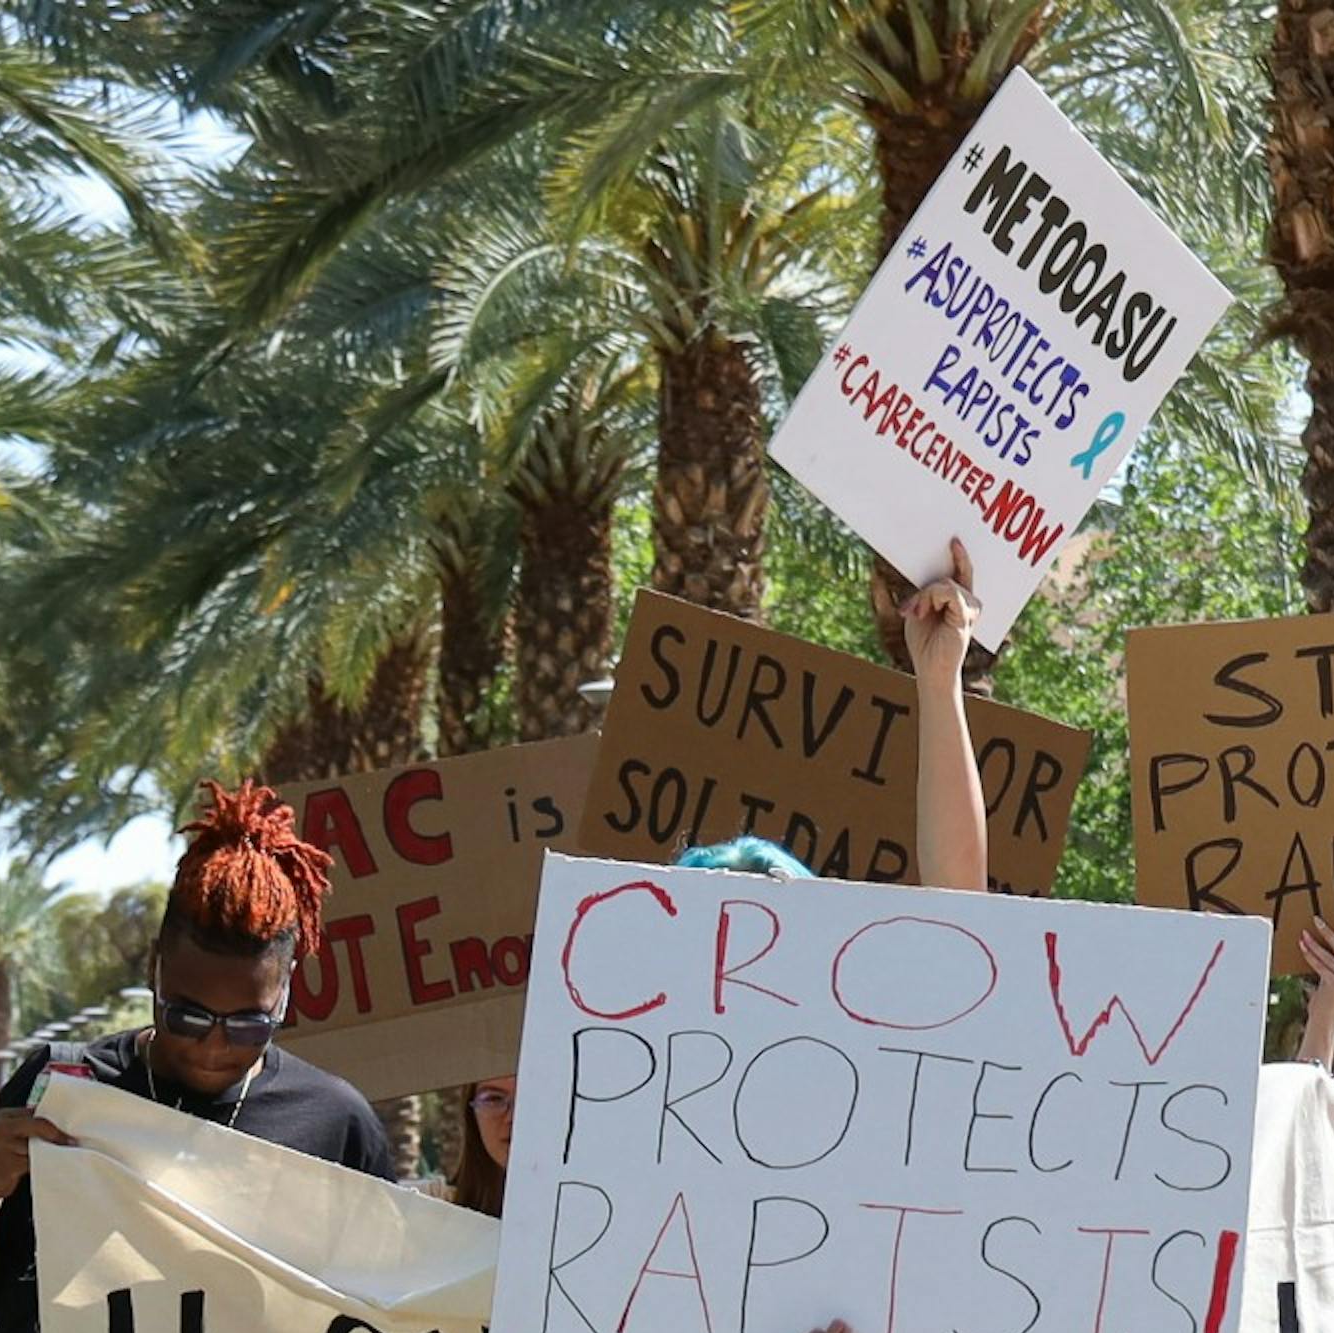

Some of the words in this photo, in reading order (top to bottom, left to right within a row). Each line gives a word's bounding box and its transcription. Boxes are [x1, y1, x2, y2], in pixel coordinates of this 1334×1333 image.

[905, 236, 1090, 430] #ASUPROTECTS
[963, 142, 1177, 382] #METOOASU
[833, 343, 1063, 567] #CAARECENTERNOW
[924, 346, 1040, 467] RAPISTS
[505, 787, 563, 842] is
[640, 624, 1063, 842] SURVIOR
[285, 914, 375, 1027] OT
[395, 896, 534, 1005] Eno
[561, 880, 1225, 1064] CROW
[563, 1026, 1232, 1191] PROTECTS
